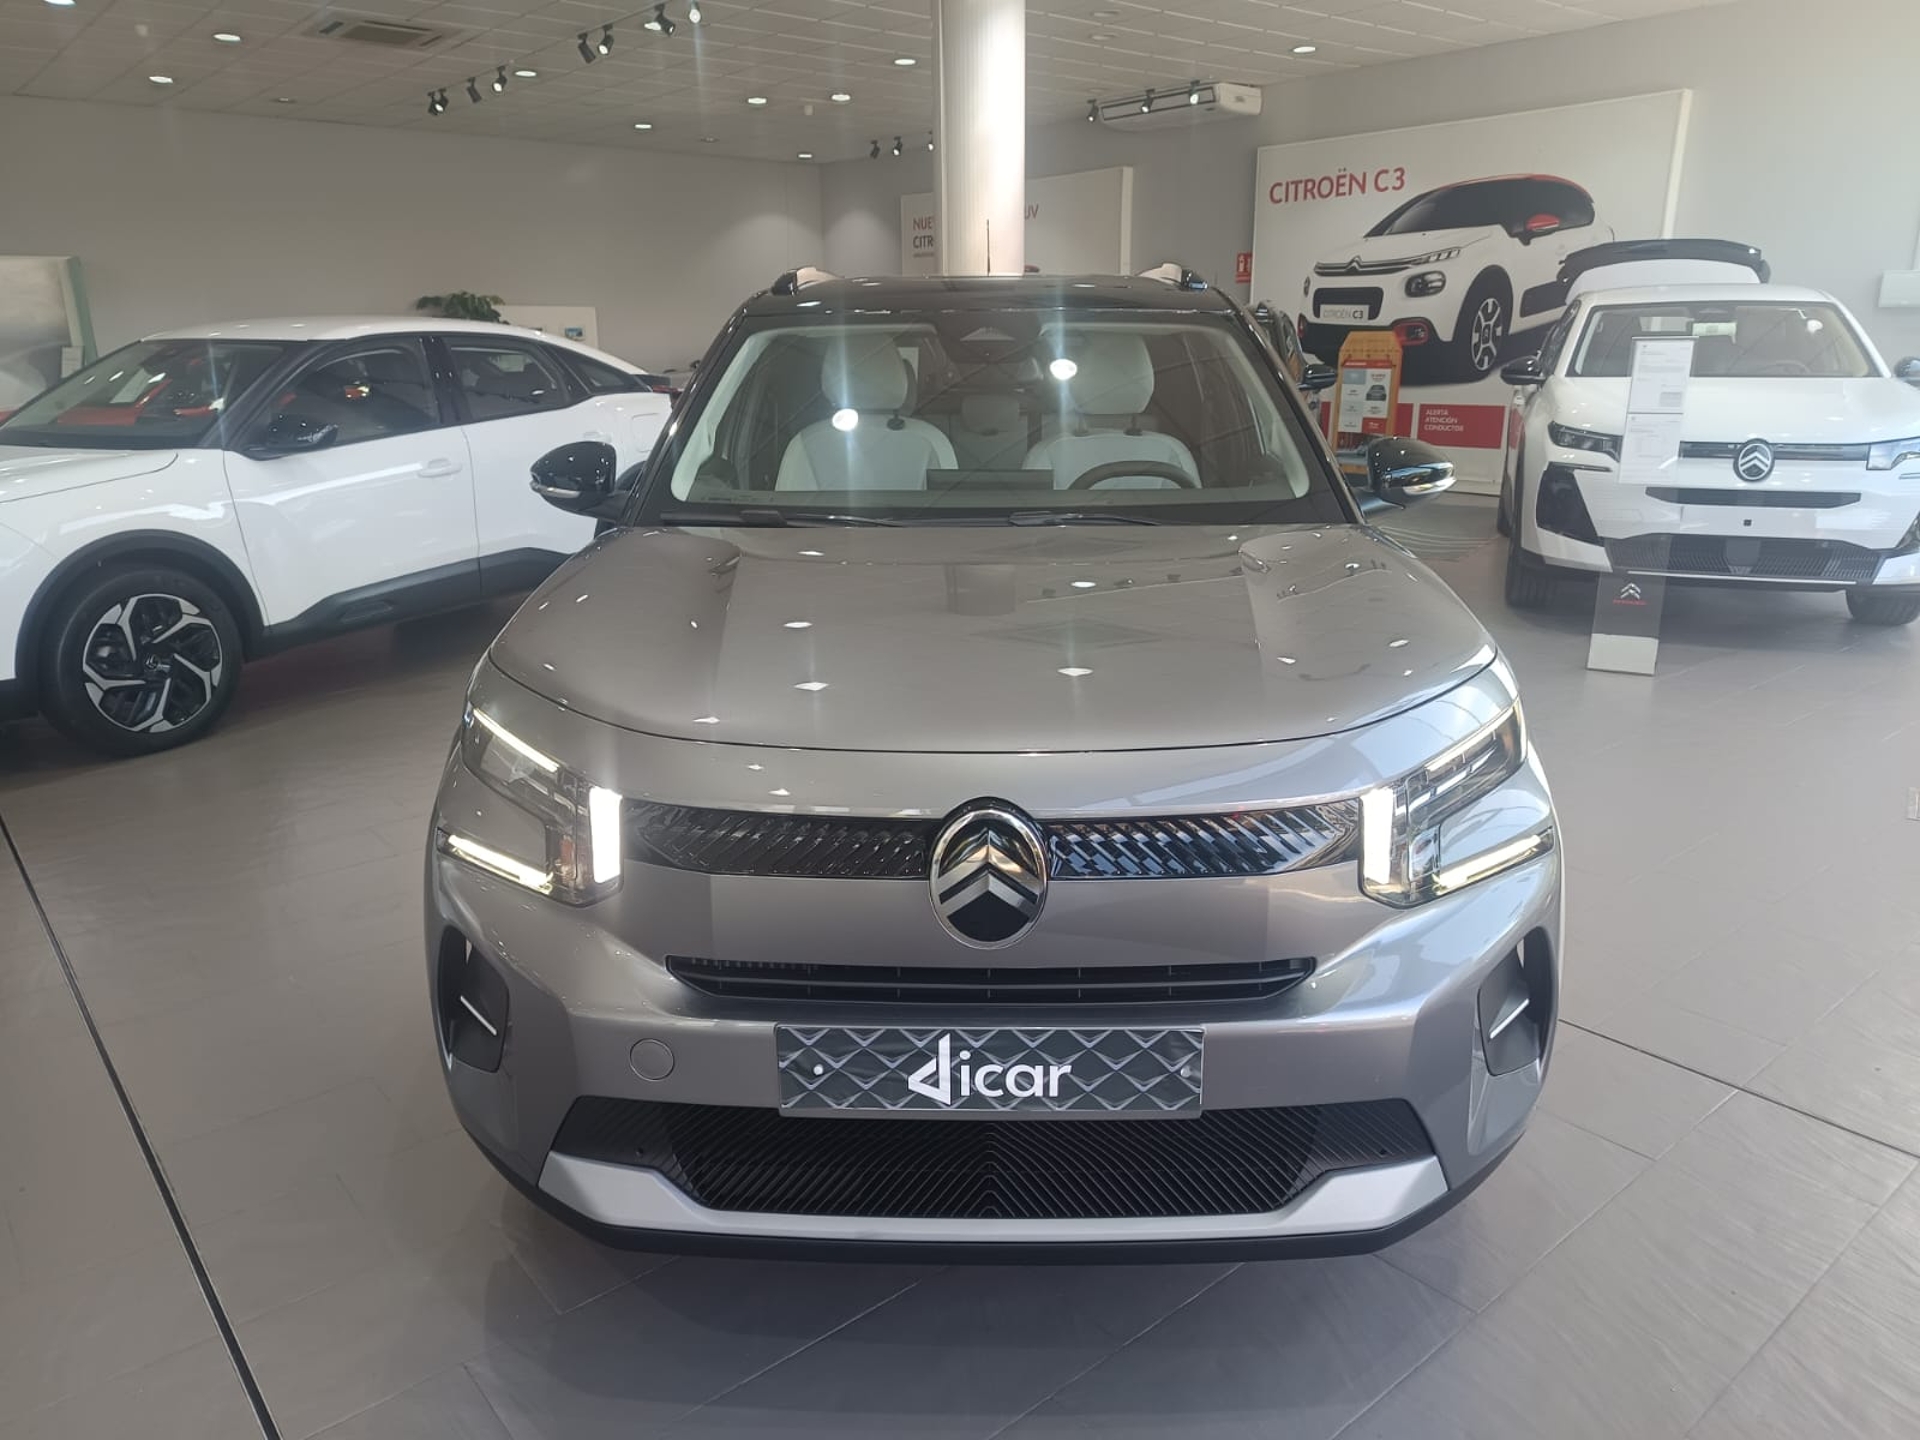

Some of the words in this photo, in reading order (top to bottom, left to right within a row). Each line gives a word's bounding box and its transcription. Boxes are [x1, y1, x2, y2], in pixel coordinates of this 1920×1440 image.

[1269, 167, 1367, 205] CITROËN
[1374, 166, 1405, 193] C3
[912, 216, 934, 231] NUE
[1024, 203, 1039, 220] UV
[912, 235, 934, 249] CITR
[1352, 310, 1364, 319] C3
[1425, 408, 1449, 416] ALERTA
[1423, 424, 1464, 432] CONDUCTOR
[908, 1032, 1073, 1106] dicar
